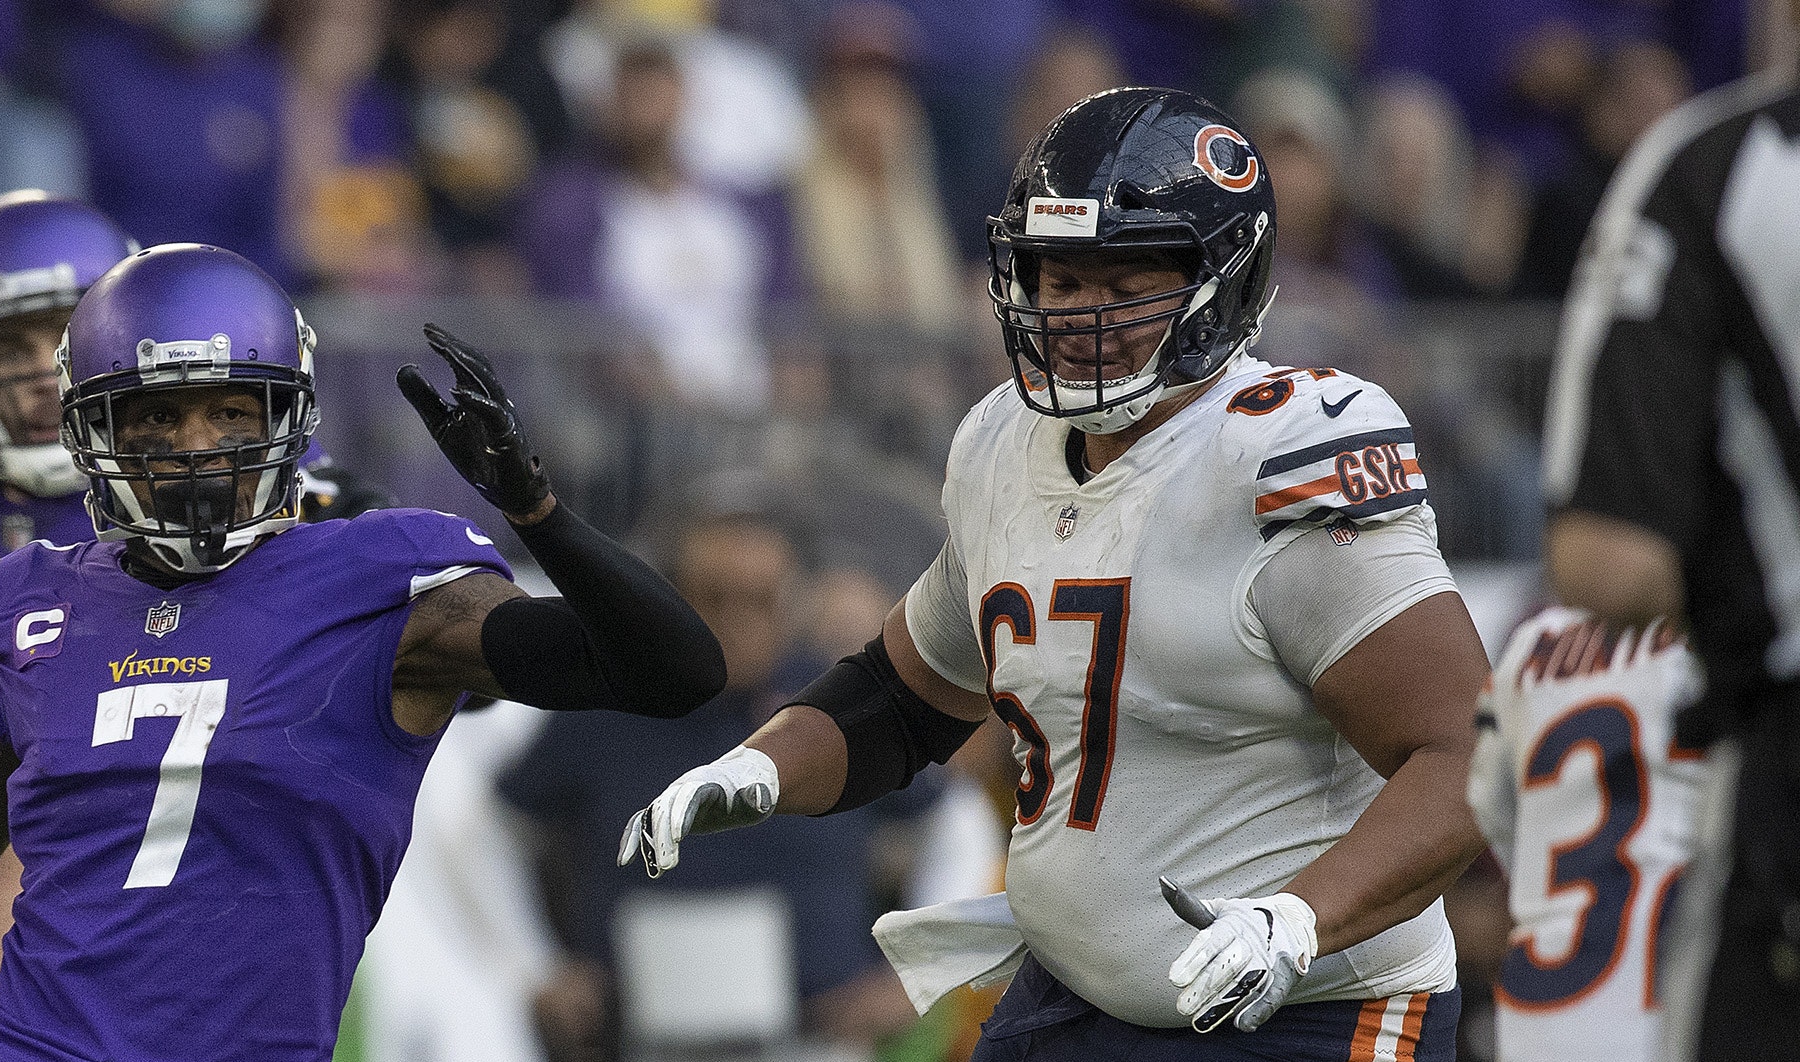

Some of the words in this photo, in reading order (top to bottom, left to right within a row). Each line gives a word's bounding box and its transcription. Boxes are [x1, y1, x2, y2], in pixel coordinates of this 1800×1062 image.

[1034, 204, 1088, 216] BEARS
[1335, 443, 1411, 505] GSH
[16, 608, 65, 650] C
[978, 576, 1132, 832] 67
[91, 678, 229, 889] 7
[1494, 694, 1705, 1013] 3
